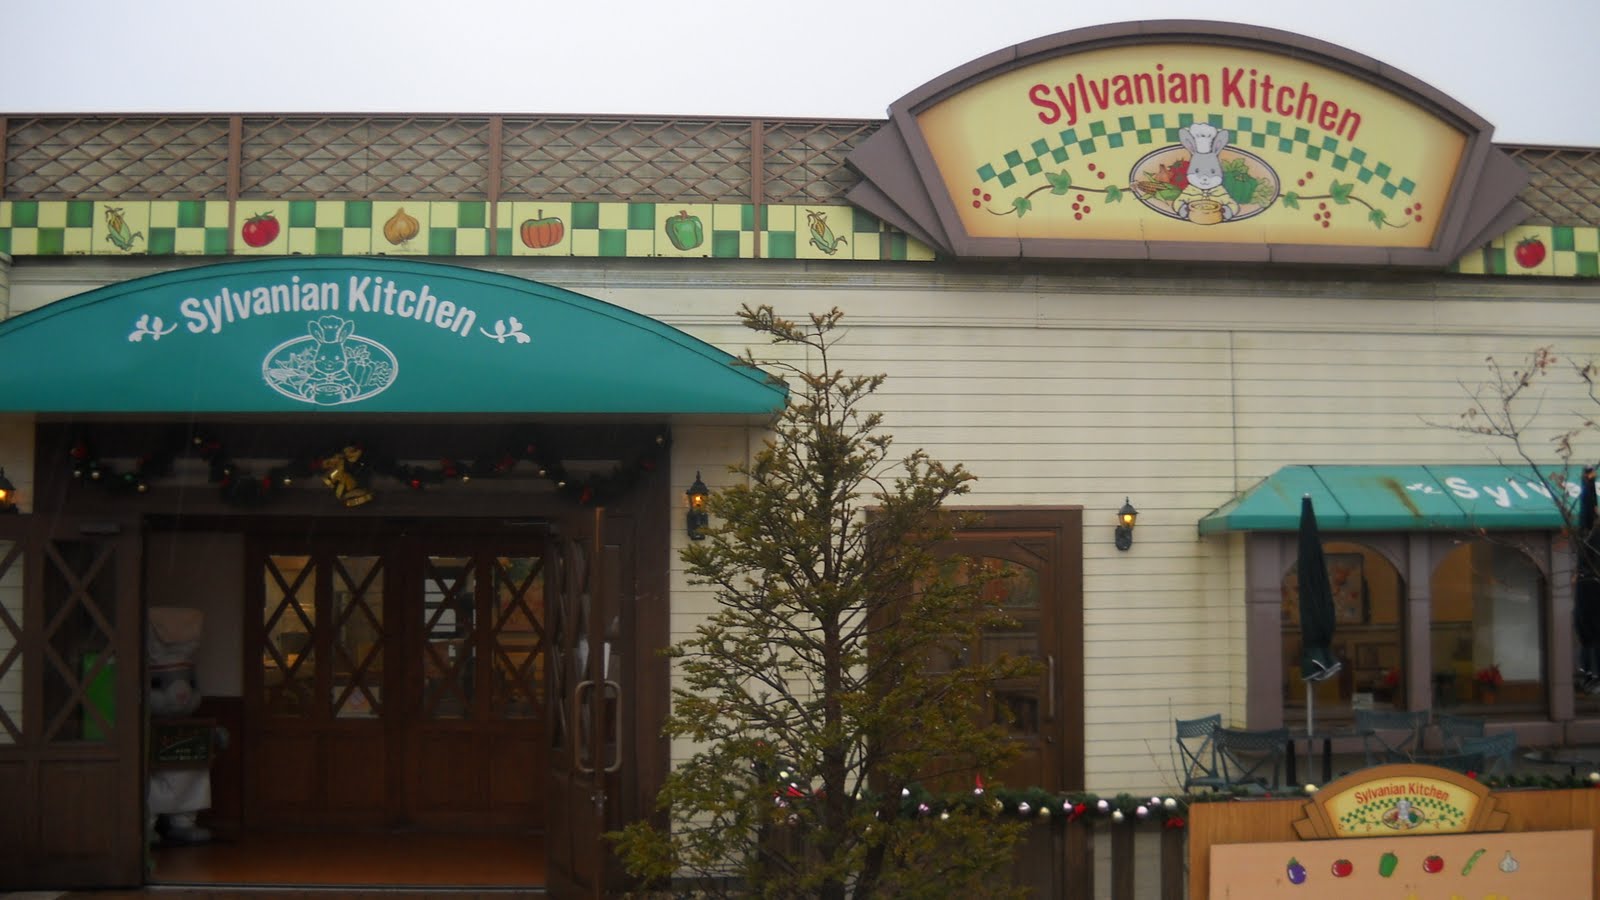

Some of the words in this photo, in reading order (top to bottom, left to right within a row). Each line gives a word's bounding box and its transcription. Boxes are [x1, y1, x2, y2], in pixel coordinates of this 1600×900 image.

[1028, 63, 1210, 126] Sylvanian
[1222, 66, 1362, 142] Kitchen
[180, 275, 339, 335] Sylvanian
[348, 275, 477, 337] Kitchen
[1354, 784, 1405, 804] Sylvanian
[1408, 783, 1449, 801] Kitchen
